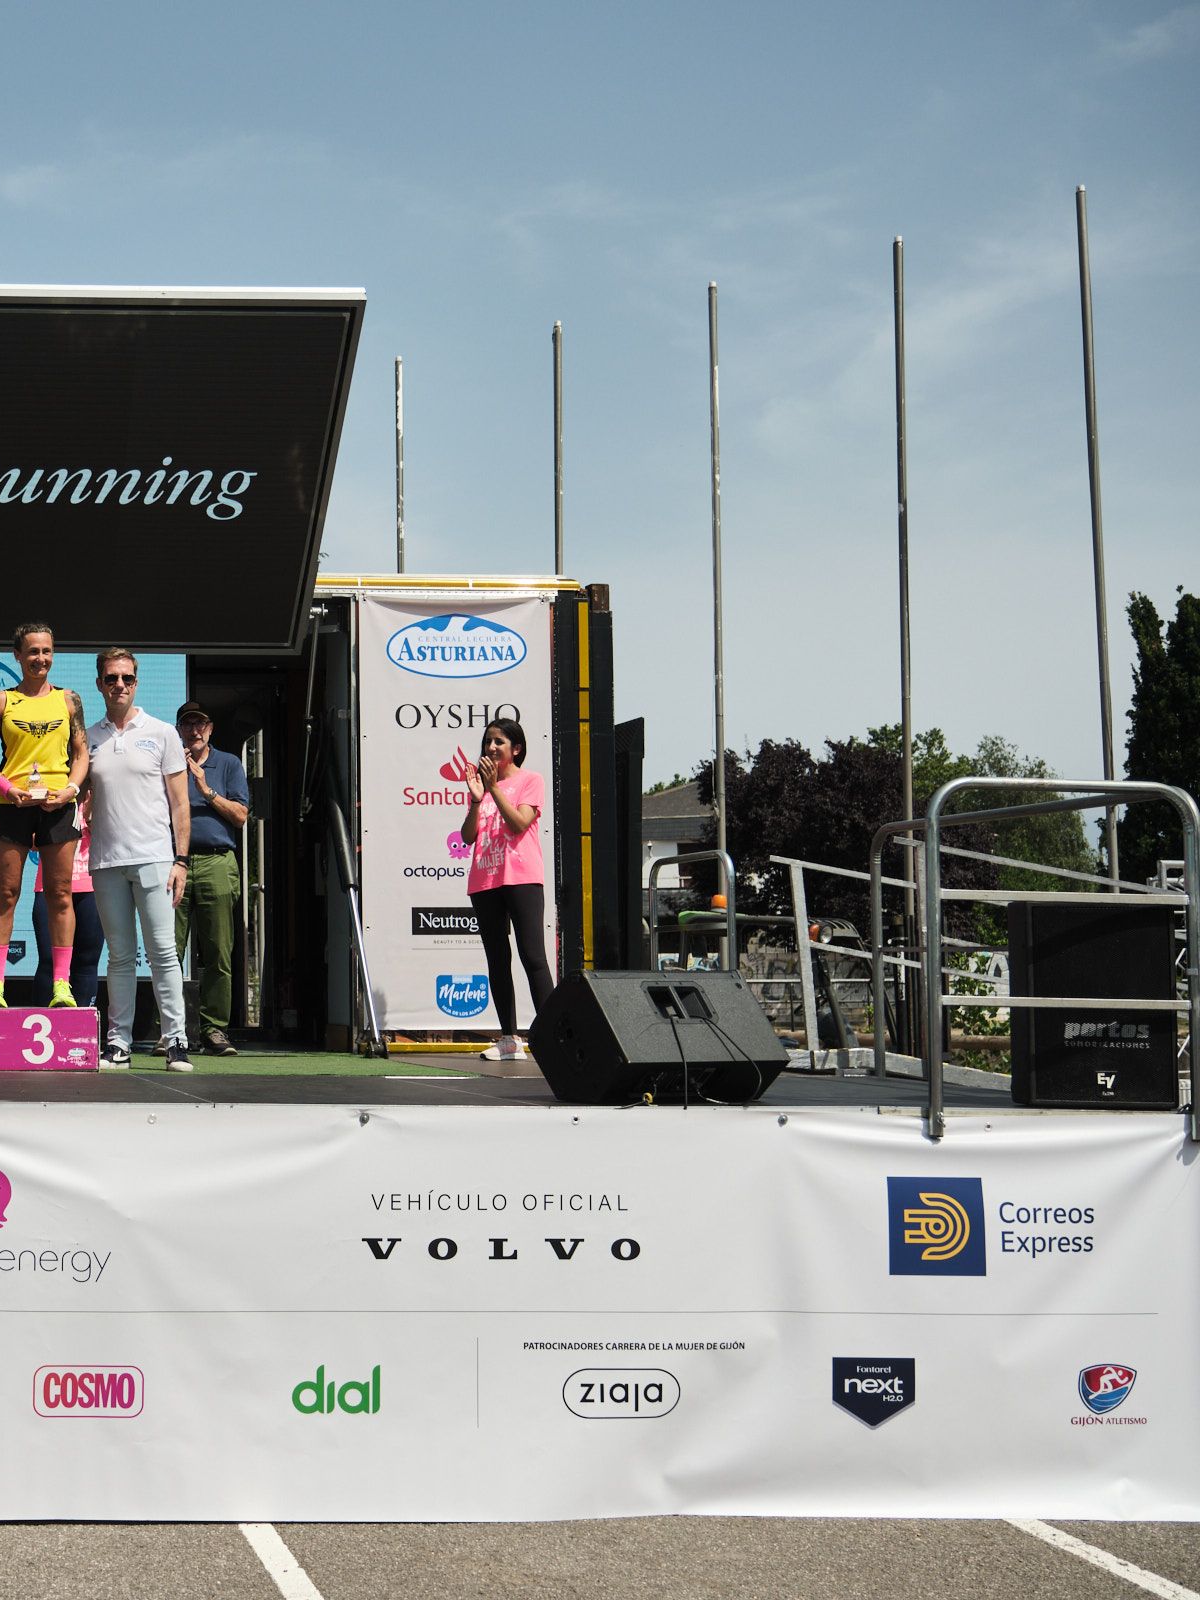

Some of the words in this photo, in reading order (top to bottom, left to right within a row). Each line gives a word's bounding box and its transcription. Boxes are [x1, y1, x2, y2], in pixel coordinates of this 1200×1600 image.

[397, 637, 517, 661] ASTURIANA
[403, 866, 465, 880] octopus
[21, 1013, 55, 1064] 3
[371, 1189, 508, 1212] VEHÍCULO
[522, 1193, 629, 1212] OFICIAL
[999, 1201, 1095, 1225] Correos
[361, 1237, 641, 1261] VOLVO
[1000, 1230, 1094, 1258] Express
[523, 1341, 604, 1351] PATROCINADORES
[605, 1342, 647, 1351] CARRERA
[648, 1342, 660, 1351] DE
[662, 1342, 674, 1351] LA
[675, 1341, 705, 1351] MUJER
[706, 1342, 718, 1350] DE
[719, 1340, 746, 1350] GIJÓN
[856, 1365, 892, 1374] Fontarel
[42, 1371, 136, 1409] COSMO
[292, 1364, 381, 1415] dial
[844, 1376, 904, 1394] next
[1070, 1415, 1104, 1426] GIJÓN
[1106, 1417, 1148, 1425] ATLETISMO
